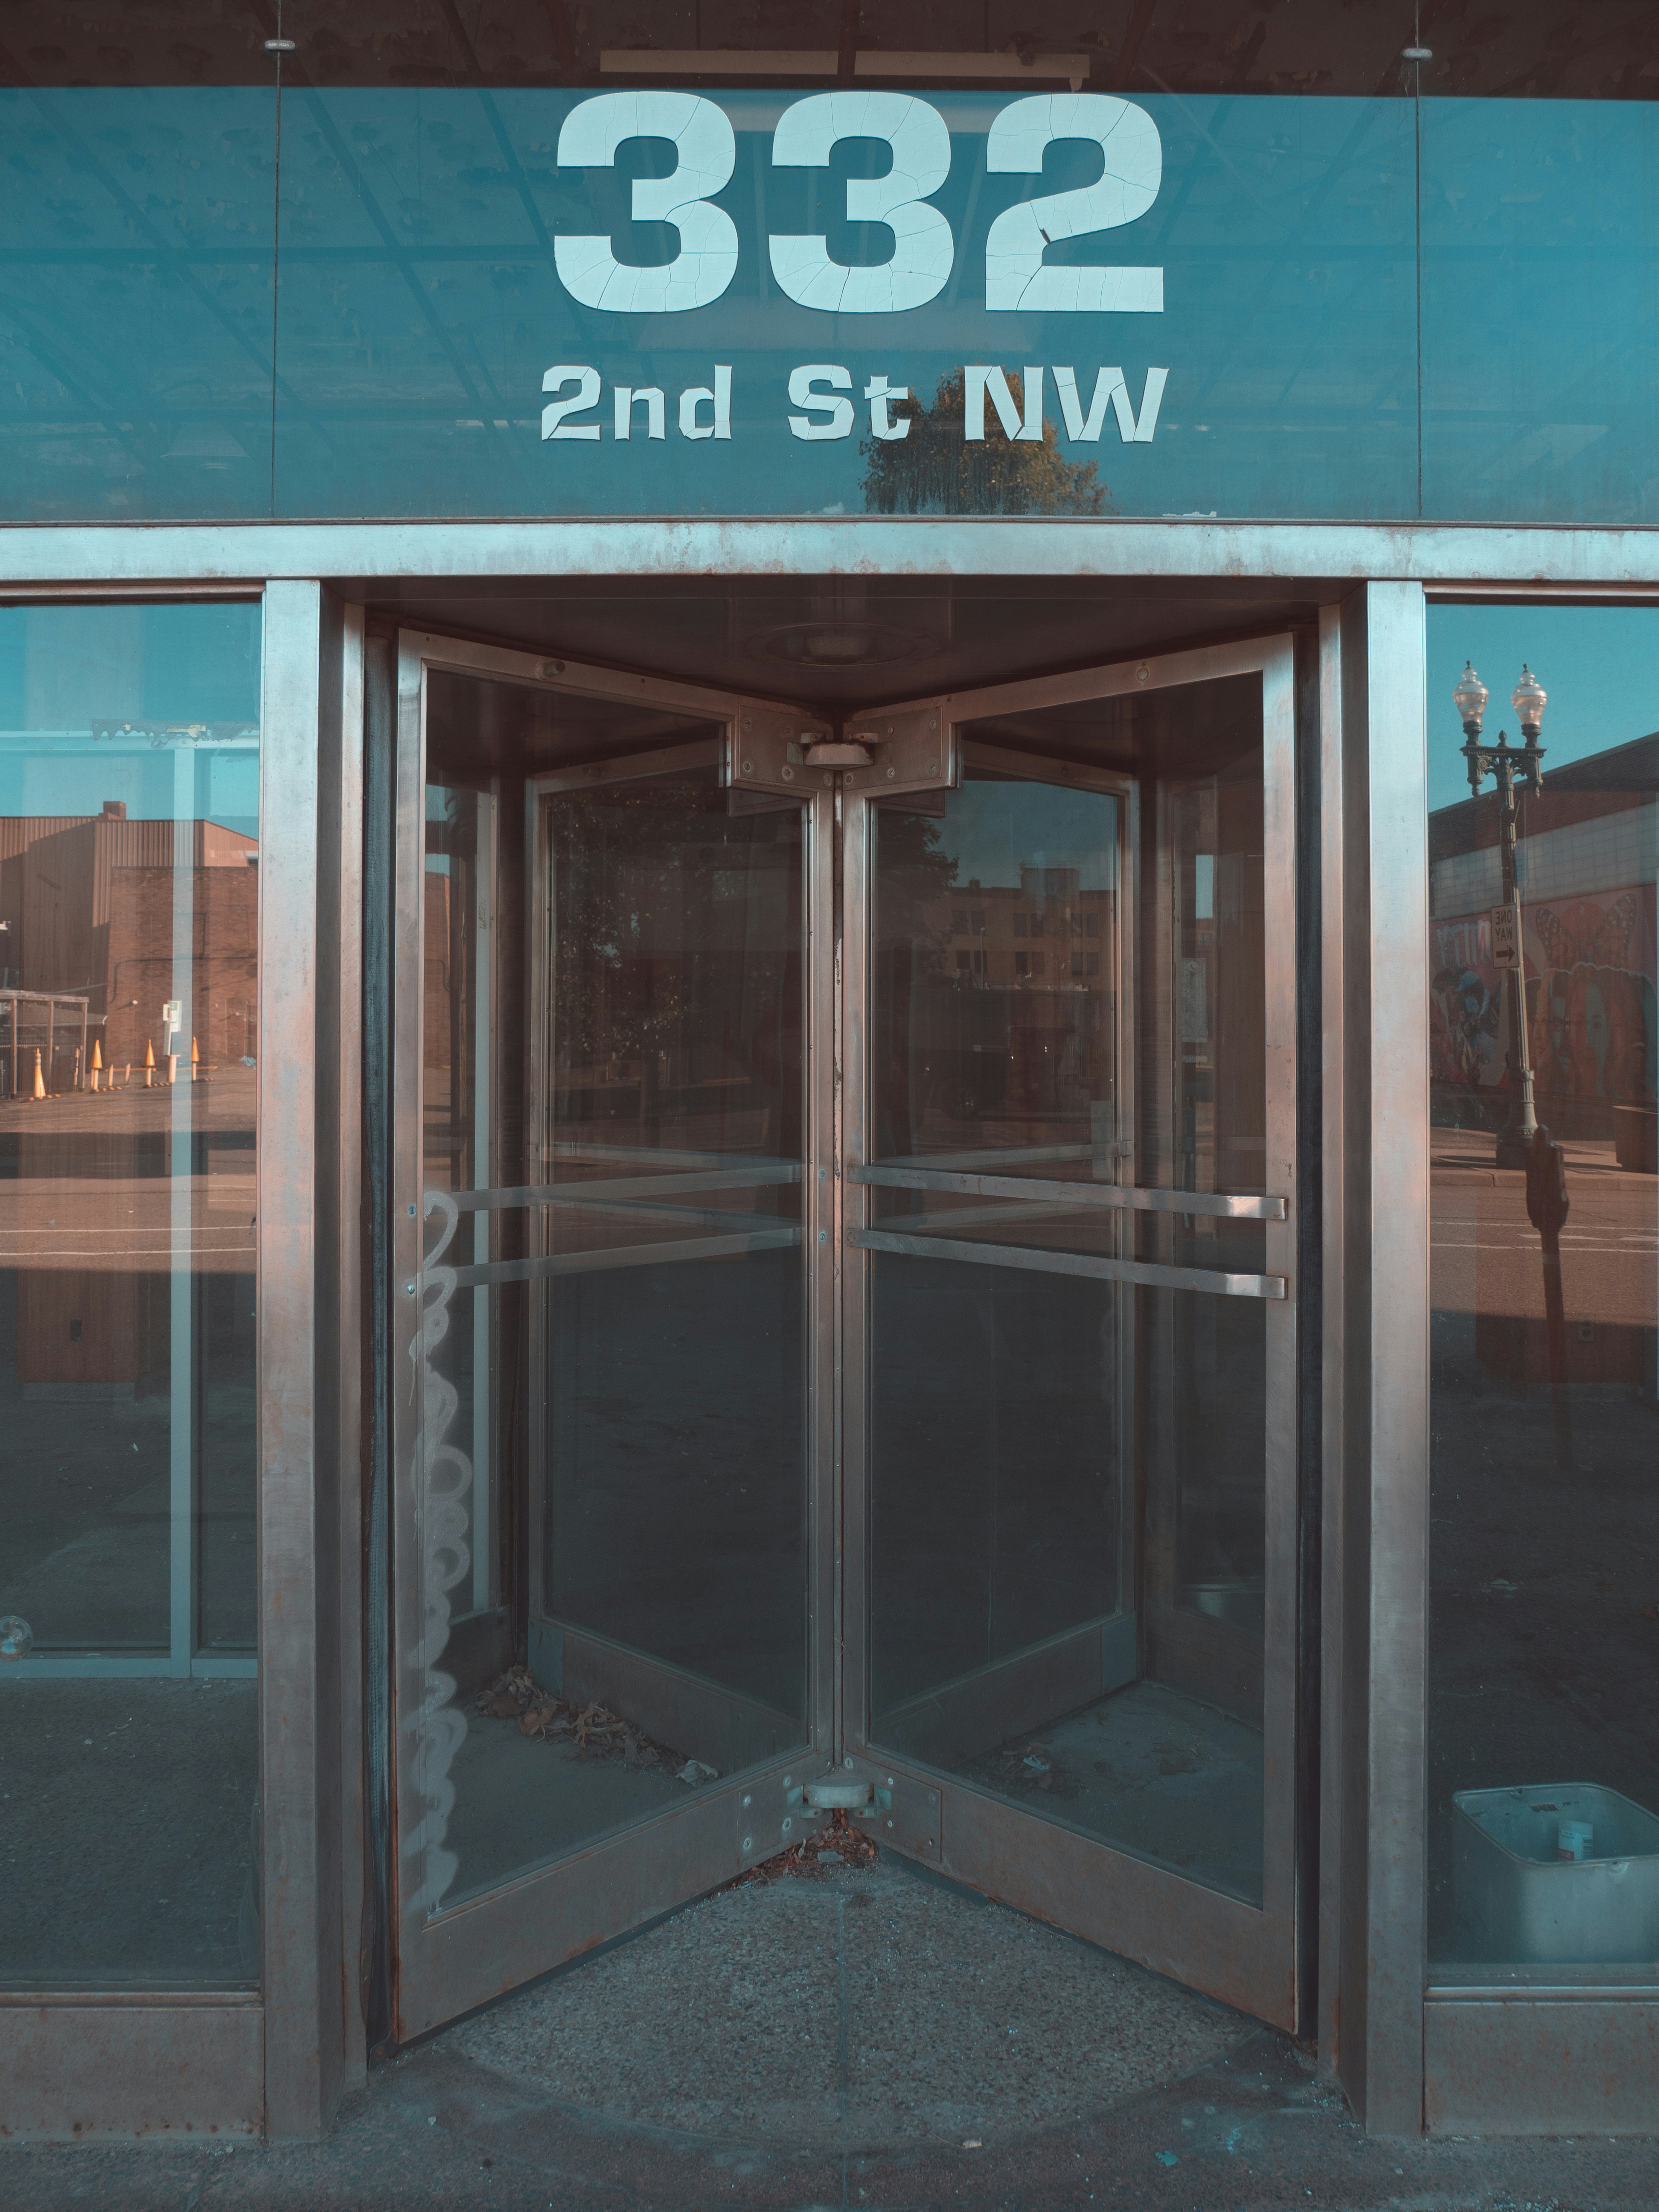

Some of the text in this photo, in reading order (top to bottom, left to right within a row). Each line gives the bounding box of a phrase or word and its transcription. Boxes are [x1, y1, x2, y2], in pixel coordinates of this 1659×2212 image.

[555, 91, 1164, 312] 332
[541, 364, 1170, 442] 2nd St NW
